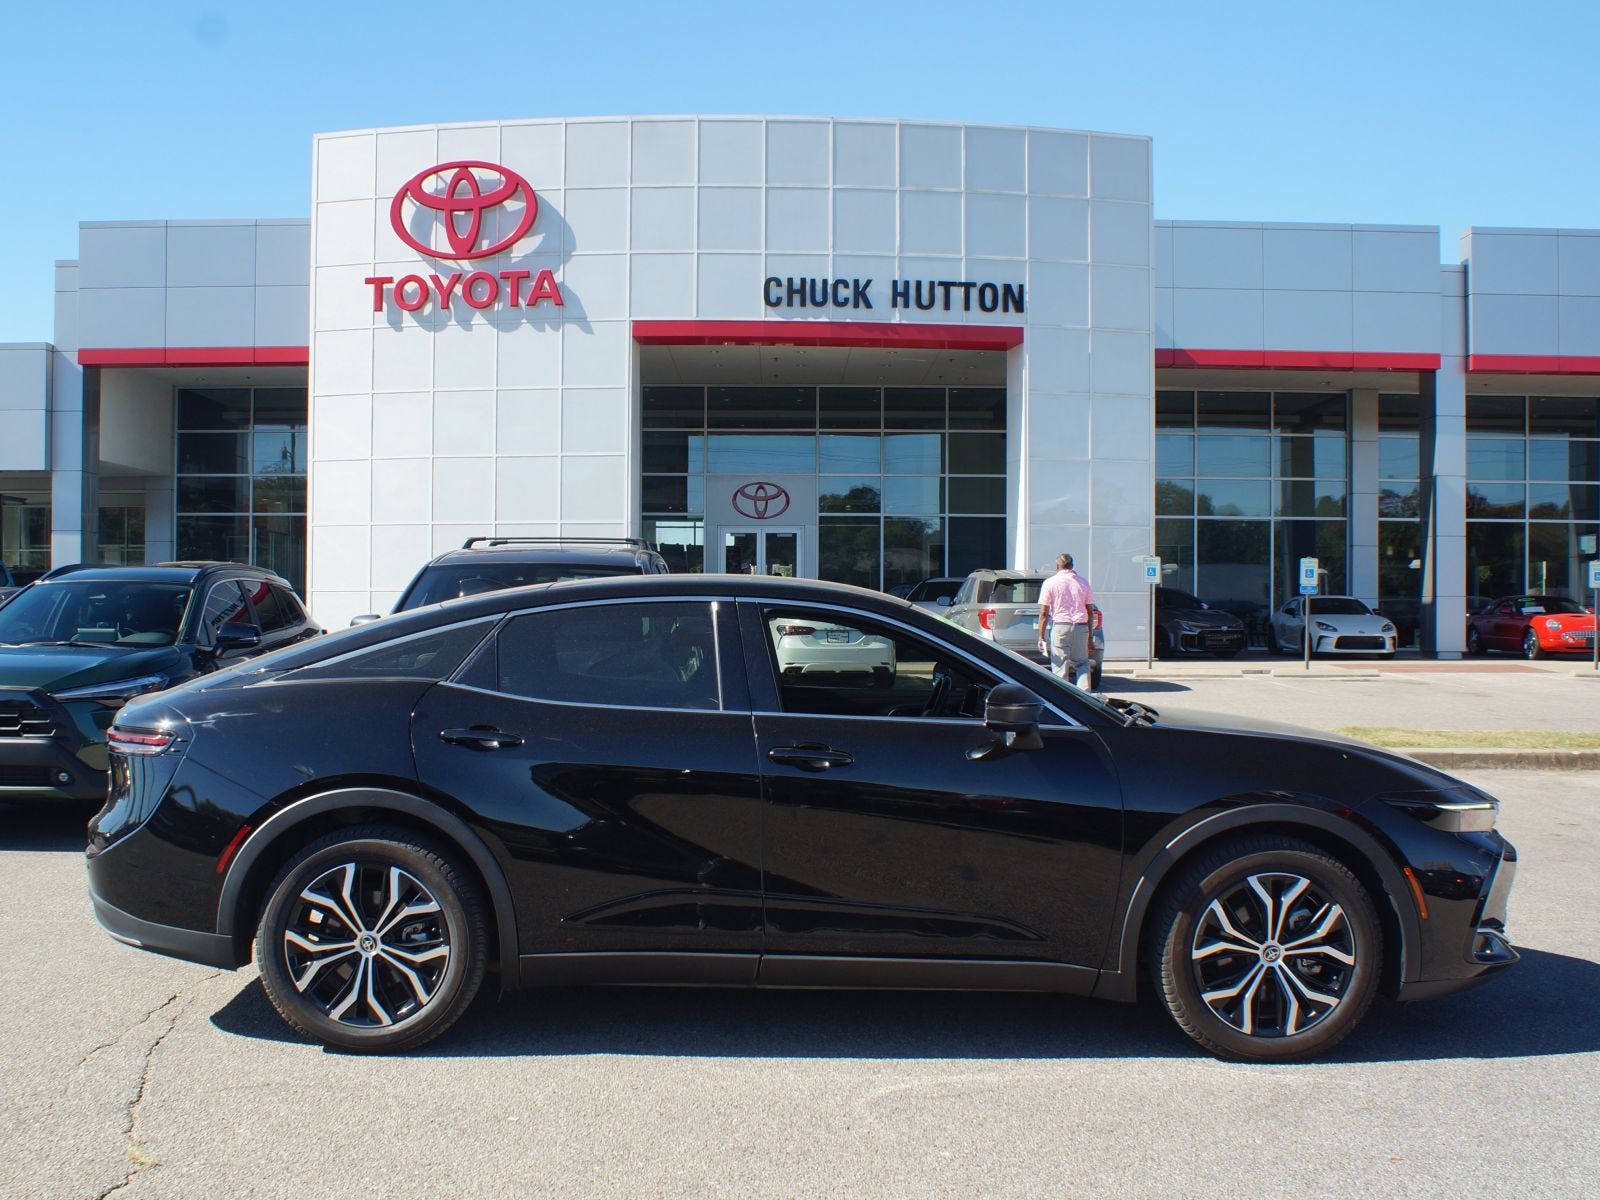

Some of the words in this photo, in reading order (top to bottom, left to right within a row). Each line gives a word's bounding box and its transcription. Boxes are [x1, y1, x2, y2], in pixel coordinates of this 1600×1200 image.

[365, 268, 564, 312] TOYOTA
[764, 276, 873, 309] CHUCK
[891, 279, 1025, 313] HUTTON
